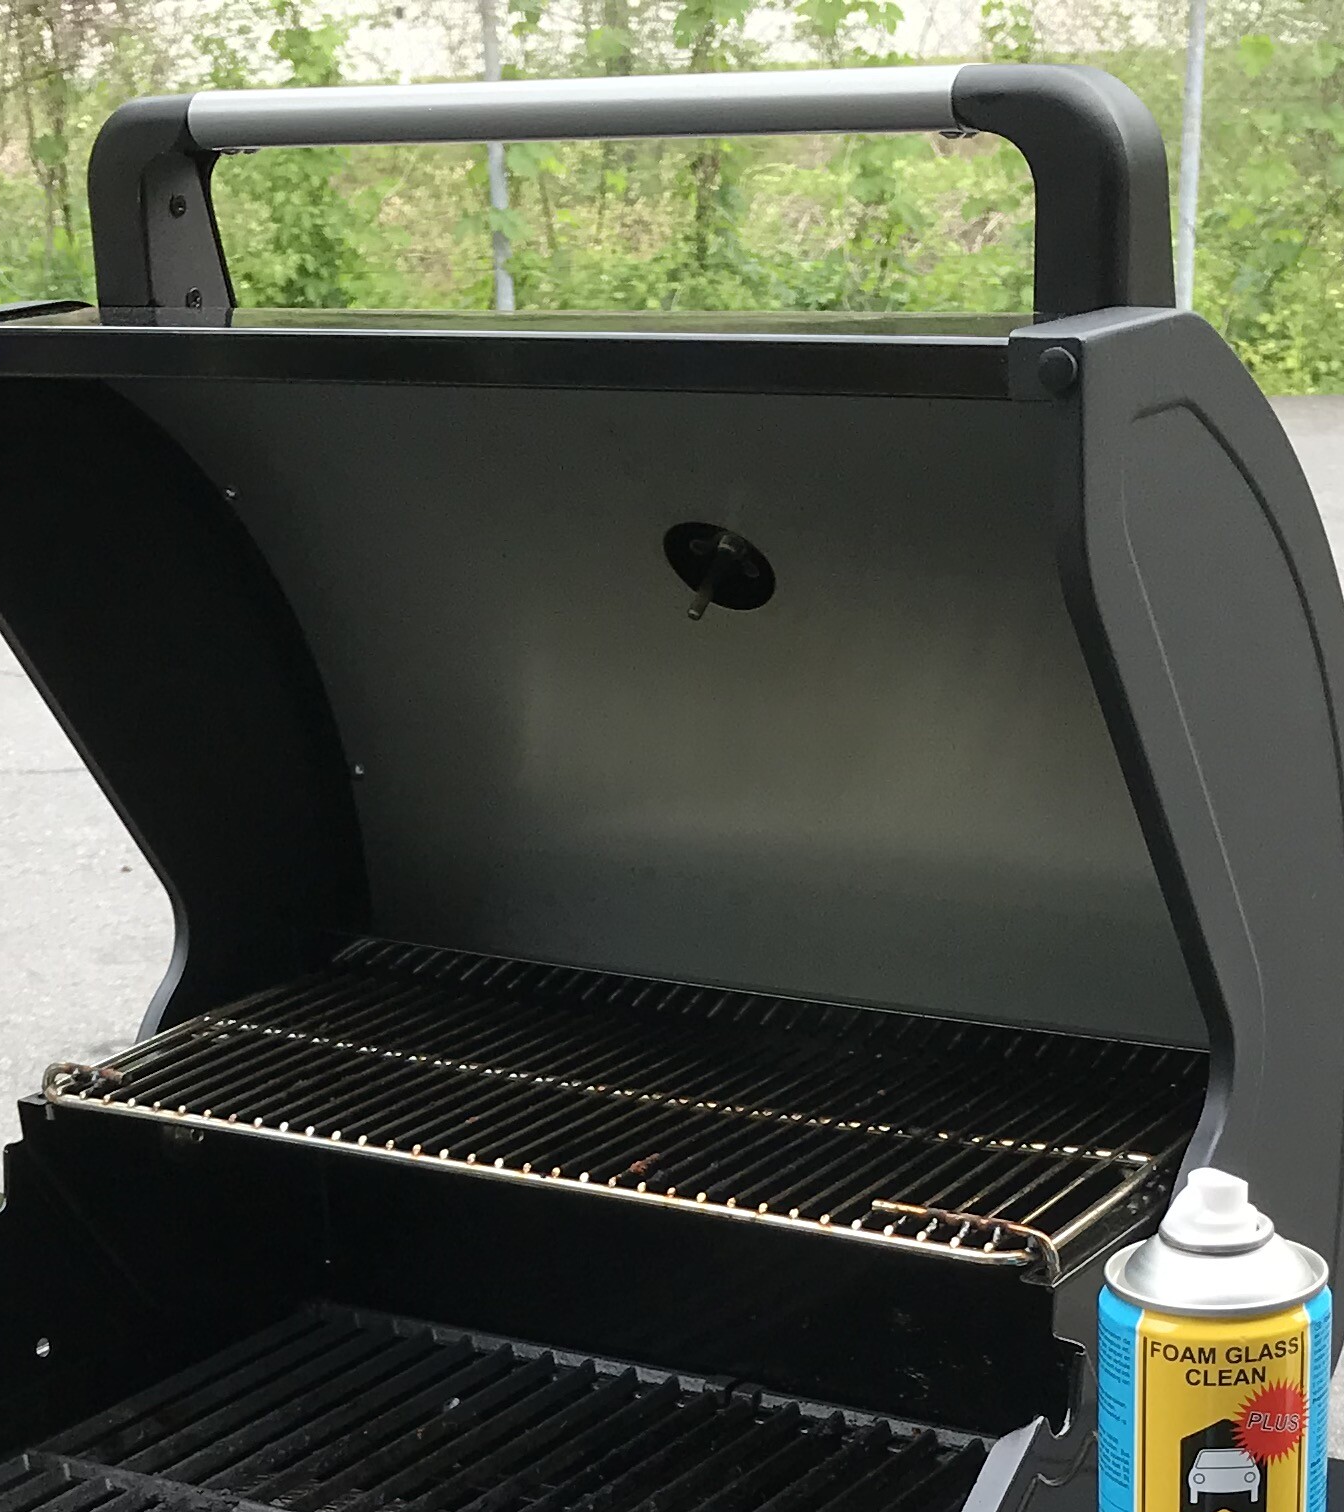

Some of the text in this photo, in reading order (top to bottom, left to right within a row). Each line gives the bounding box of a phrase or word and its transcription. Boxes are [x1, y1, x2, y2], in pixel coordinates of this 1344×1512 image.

[1150, 1337, 1299, 1364] FOAM GLASS
[1185, 1366, 1266, 1387] CLEAN
[1247, 1412, 1299, 1432] PLUS
